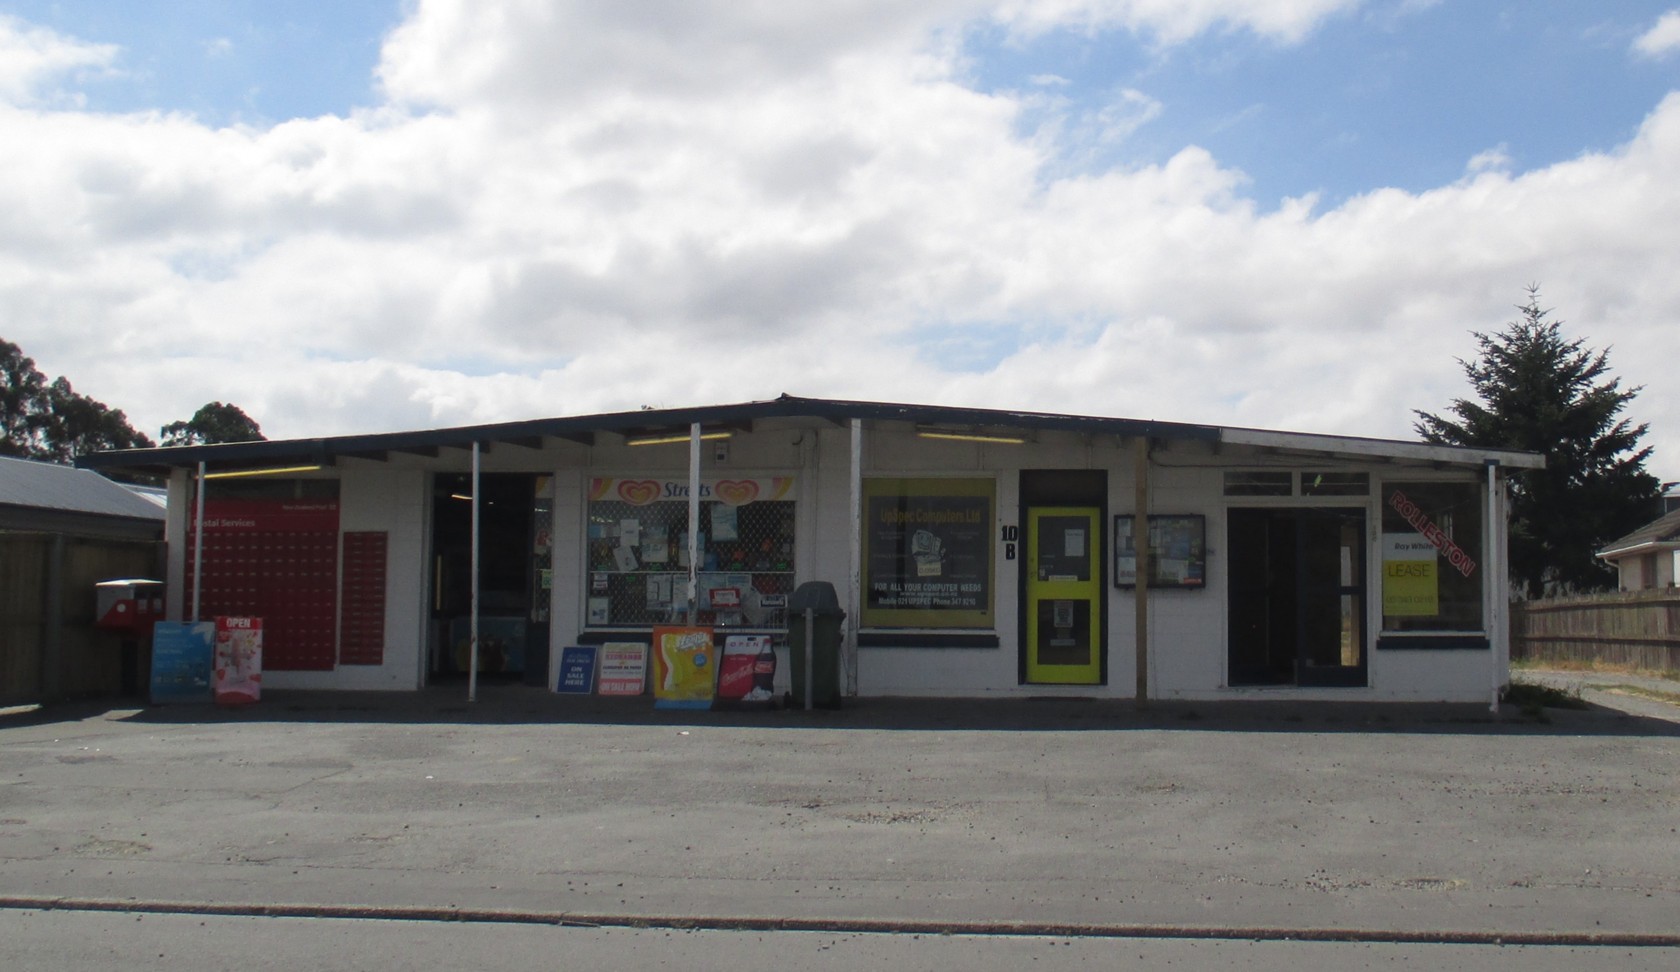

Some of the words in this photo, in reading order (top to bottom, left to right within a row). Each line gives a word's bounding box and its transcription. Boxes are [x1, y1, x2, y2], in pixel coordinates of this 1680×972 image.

[663, 481, 711, 497] Strets
[222, 518, 256, 527] Services
[880, 508, 917, 526] UpSpec
[917, 508, 964, 525] Computers
[966, 508, 981, 523] Ltd
[1001, 525, 1018, 542] 10
[1389, 489, 1476, 577] ROLLESTON
[1005, 543, 1016, 560] B
[1395, 542, 1410, 551] Ray
[1411, 542, 1434, 550] White
[1388, 563, 1431, 577] LEASE
[874, 582, 887, 591] FOR
[889, 582, 902, 591] ALL
[904, 582, 921, 591] YOUR
[923, 582, 958, 591] COMPUTER
[960, 583, 982, 592] NEEDS
[878, 597, 897, 605] Mobile
[932, 597, 951, 605] Phone
[226, 618, 251, 628] OPEN
